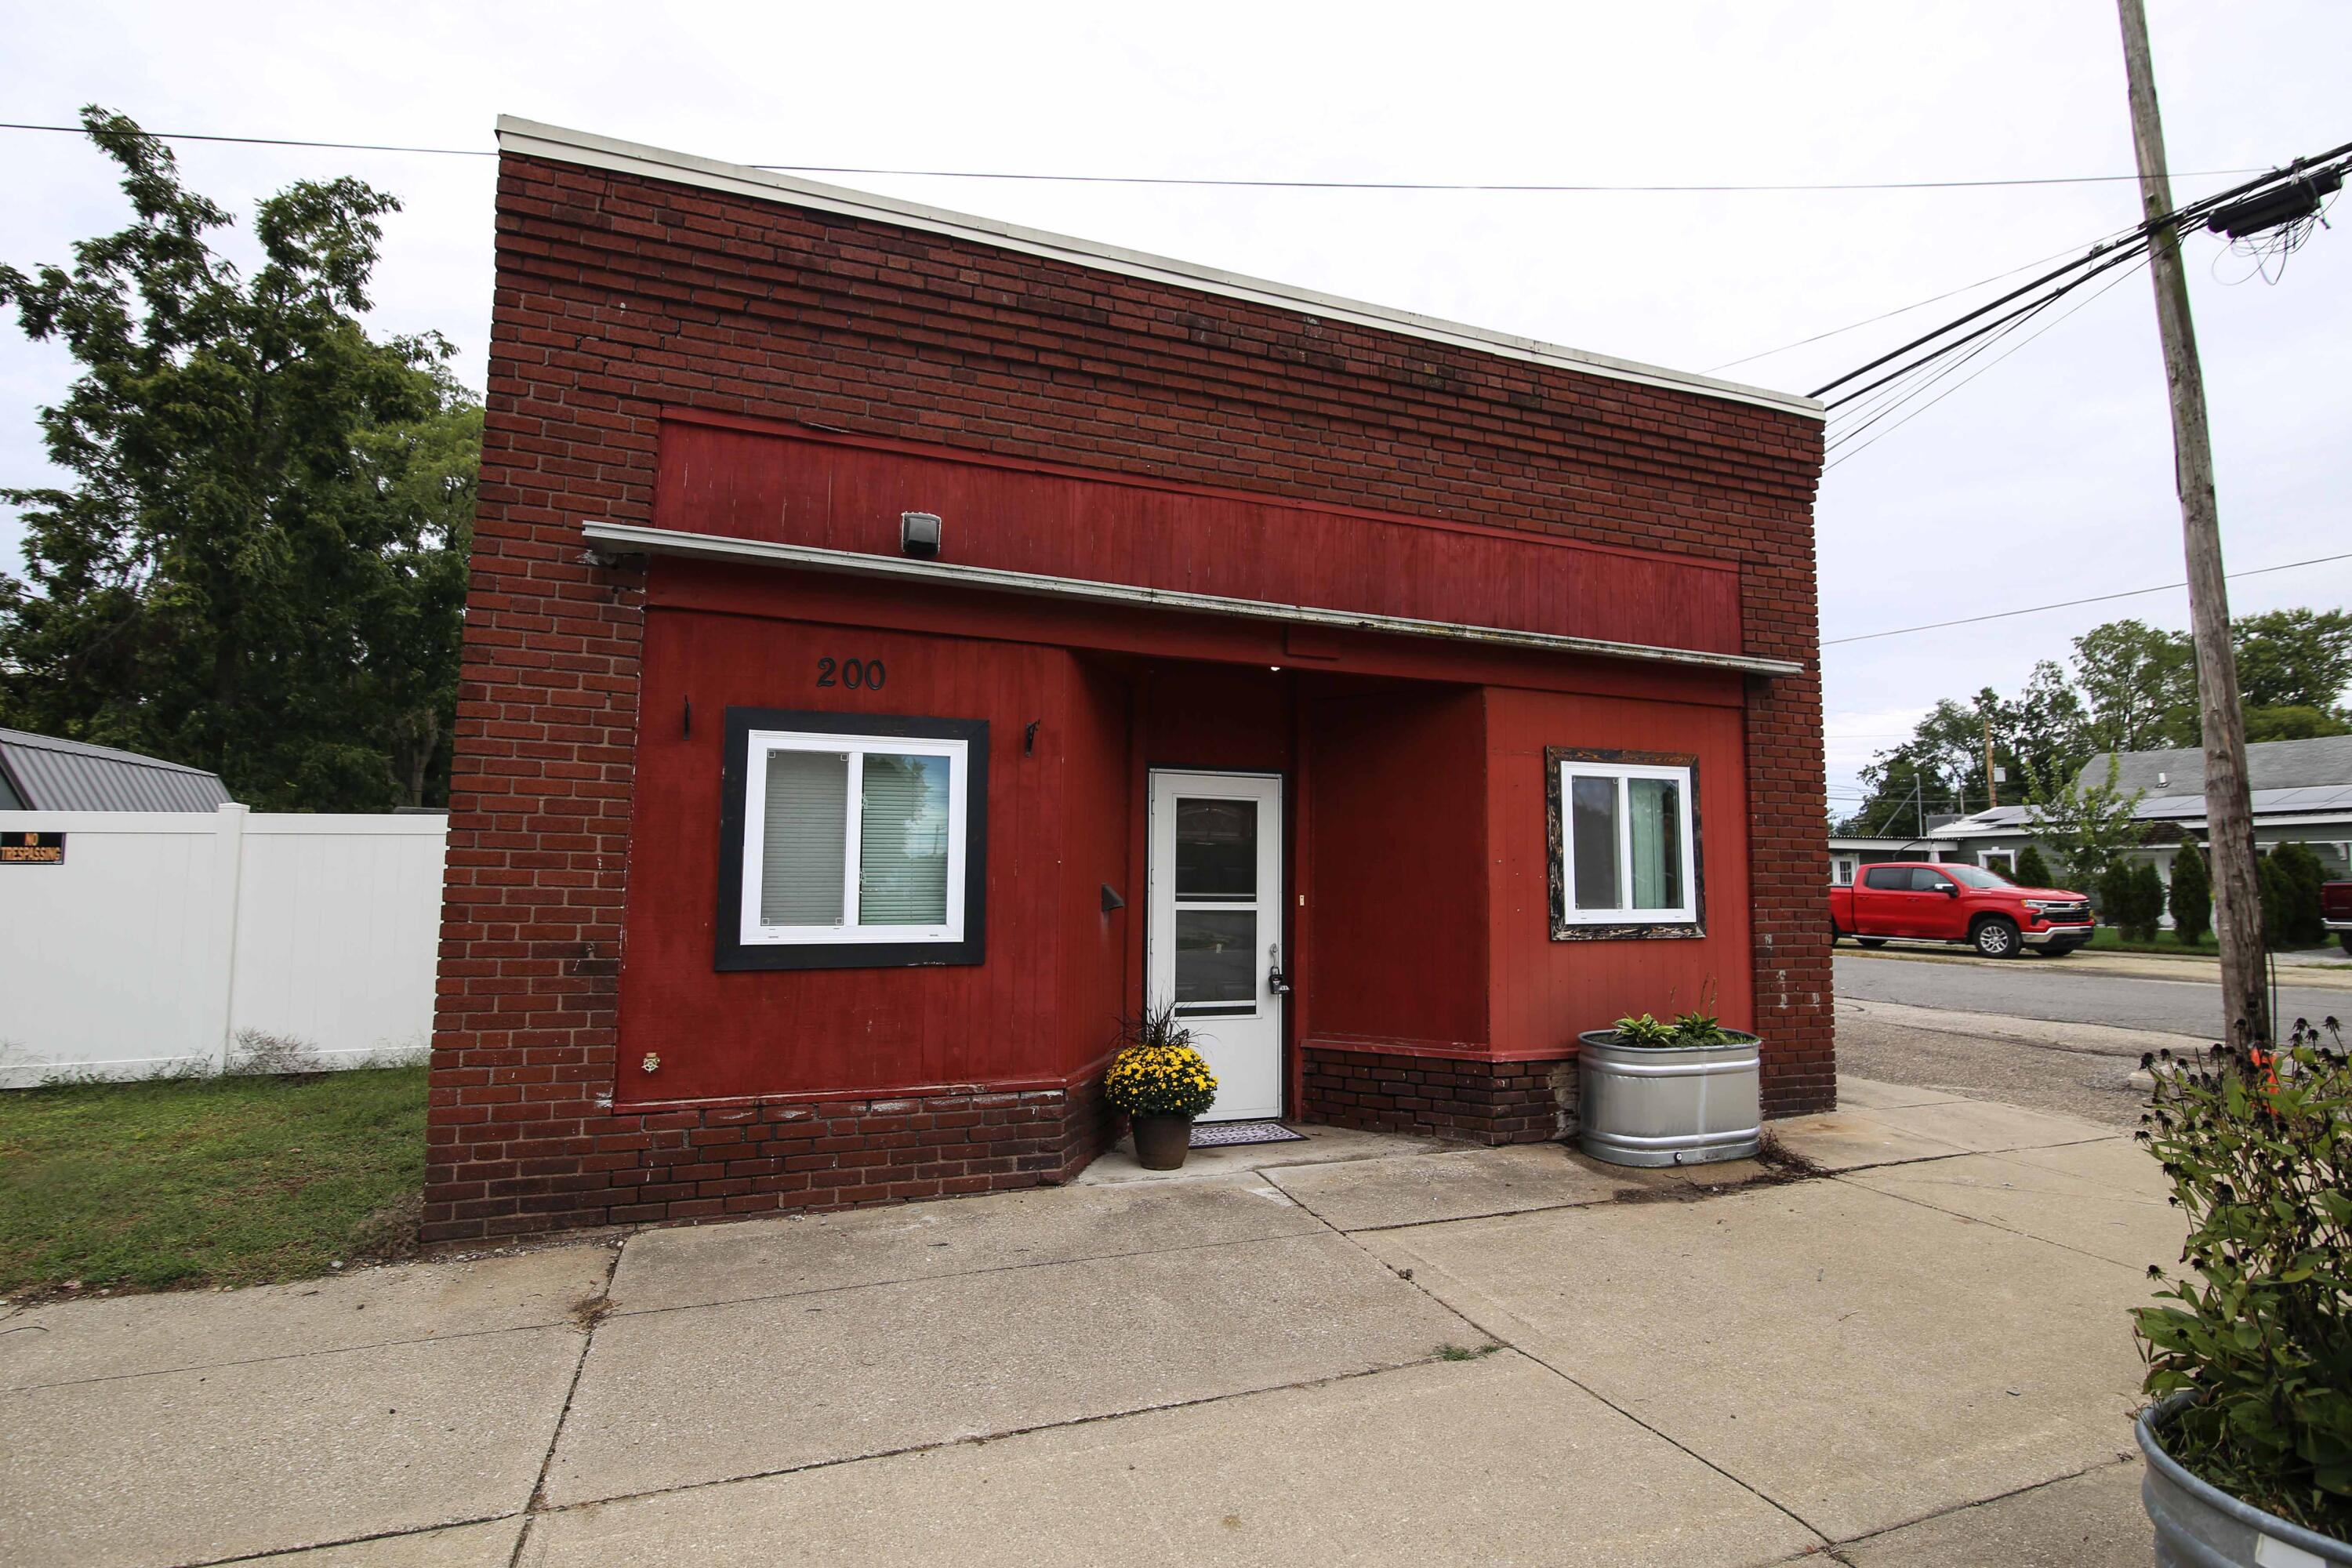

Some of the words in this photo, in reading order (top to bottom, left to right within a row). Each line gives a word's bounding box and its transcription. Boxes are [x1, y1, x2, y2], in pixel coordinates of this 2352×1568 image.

[816, 657, 886, 691] 200
[25, 833, 38, 846] NO
[0, 847, 60, 861] TRESPASSING
